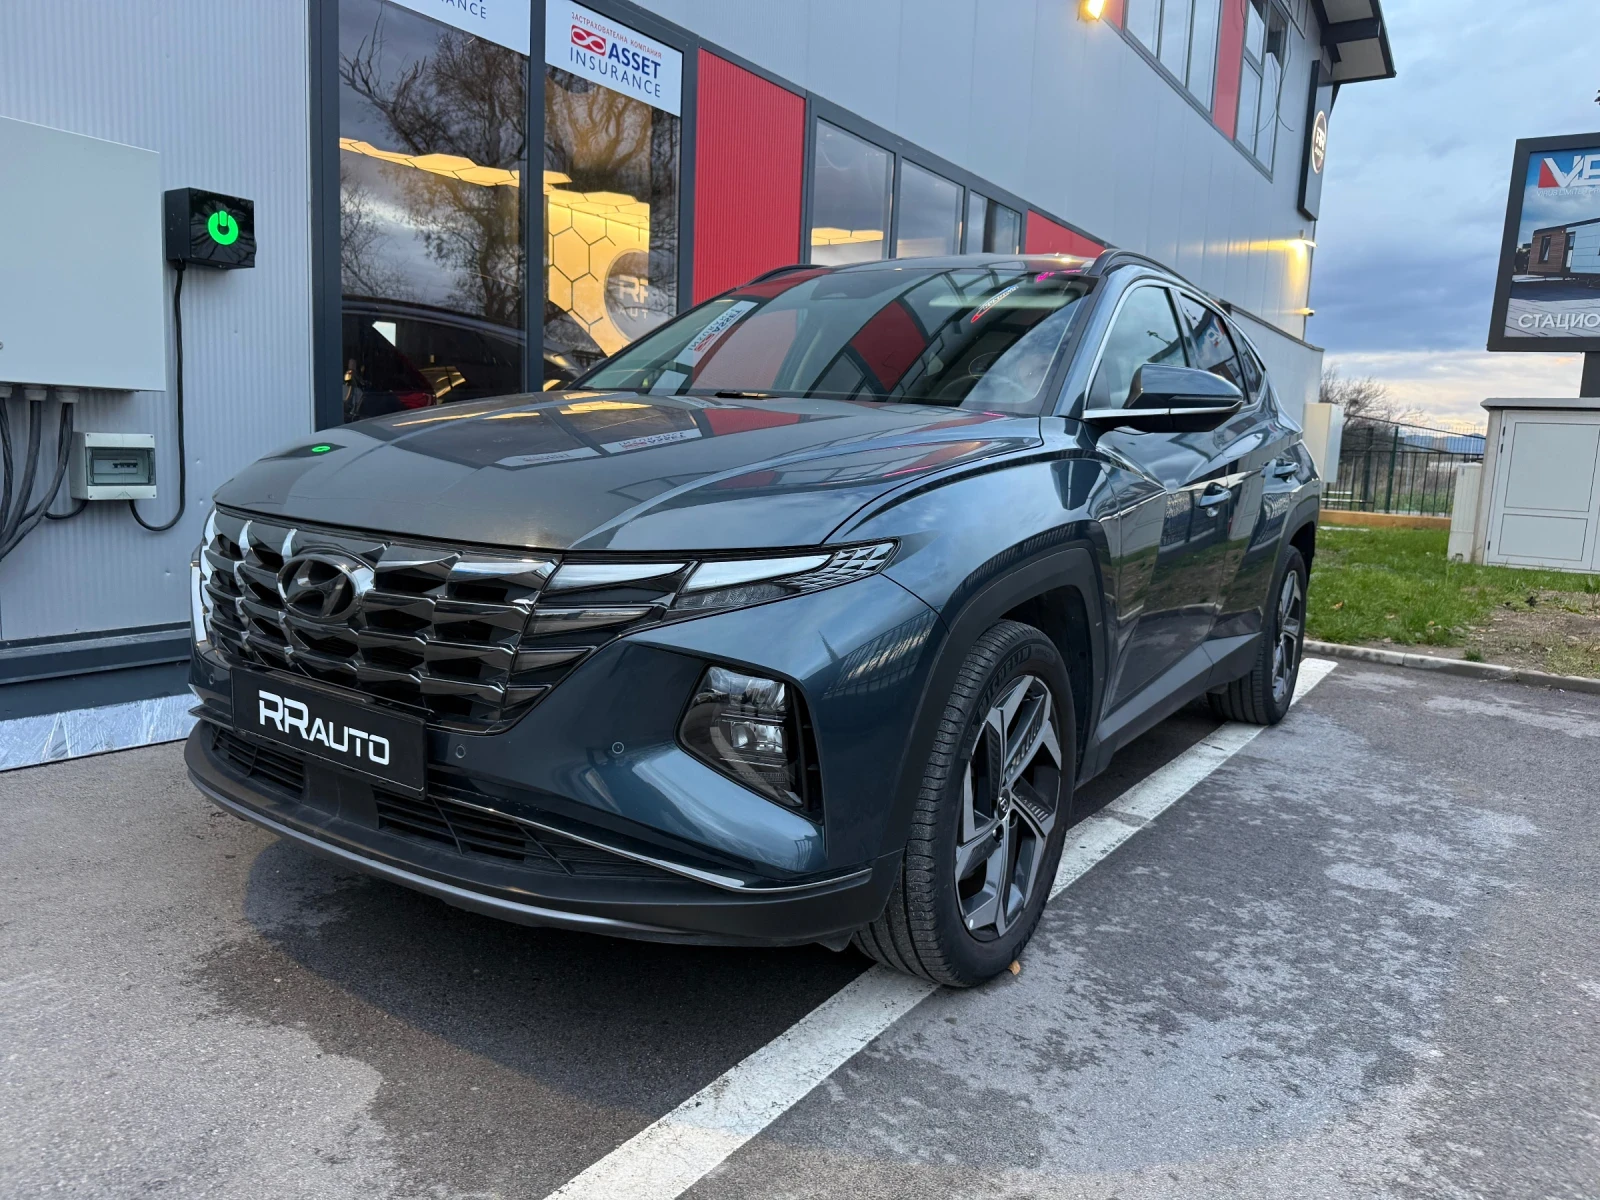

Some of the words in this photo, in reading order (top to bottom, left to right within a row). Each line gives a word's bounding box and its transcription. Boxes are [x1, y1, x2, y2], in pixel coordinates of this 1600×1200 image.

[608, 42, 661, 79] ASSET
[630, 37, 662, 60] КОМПАНИЯ
[570, 47, 661, 98] INSURANCE
